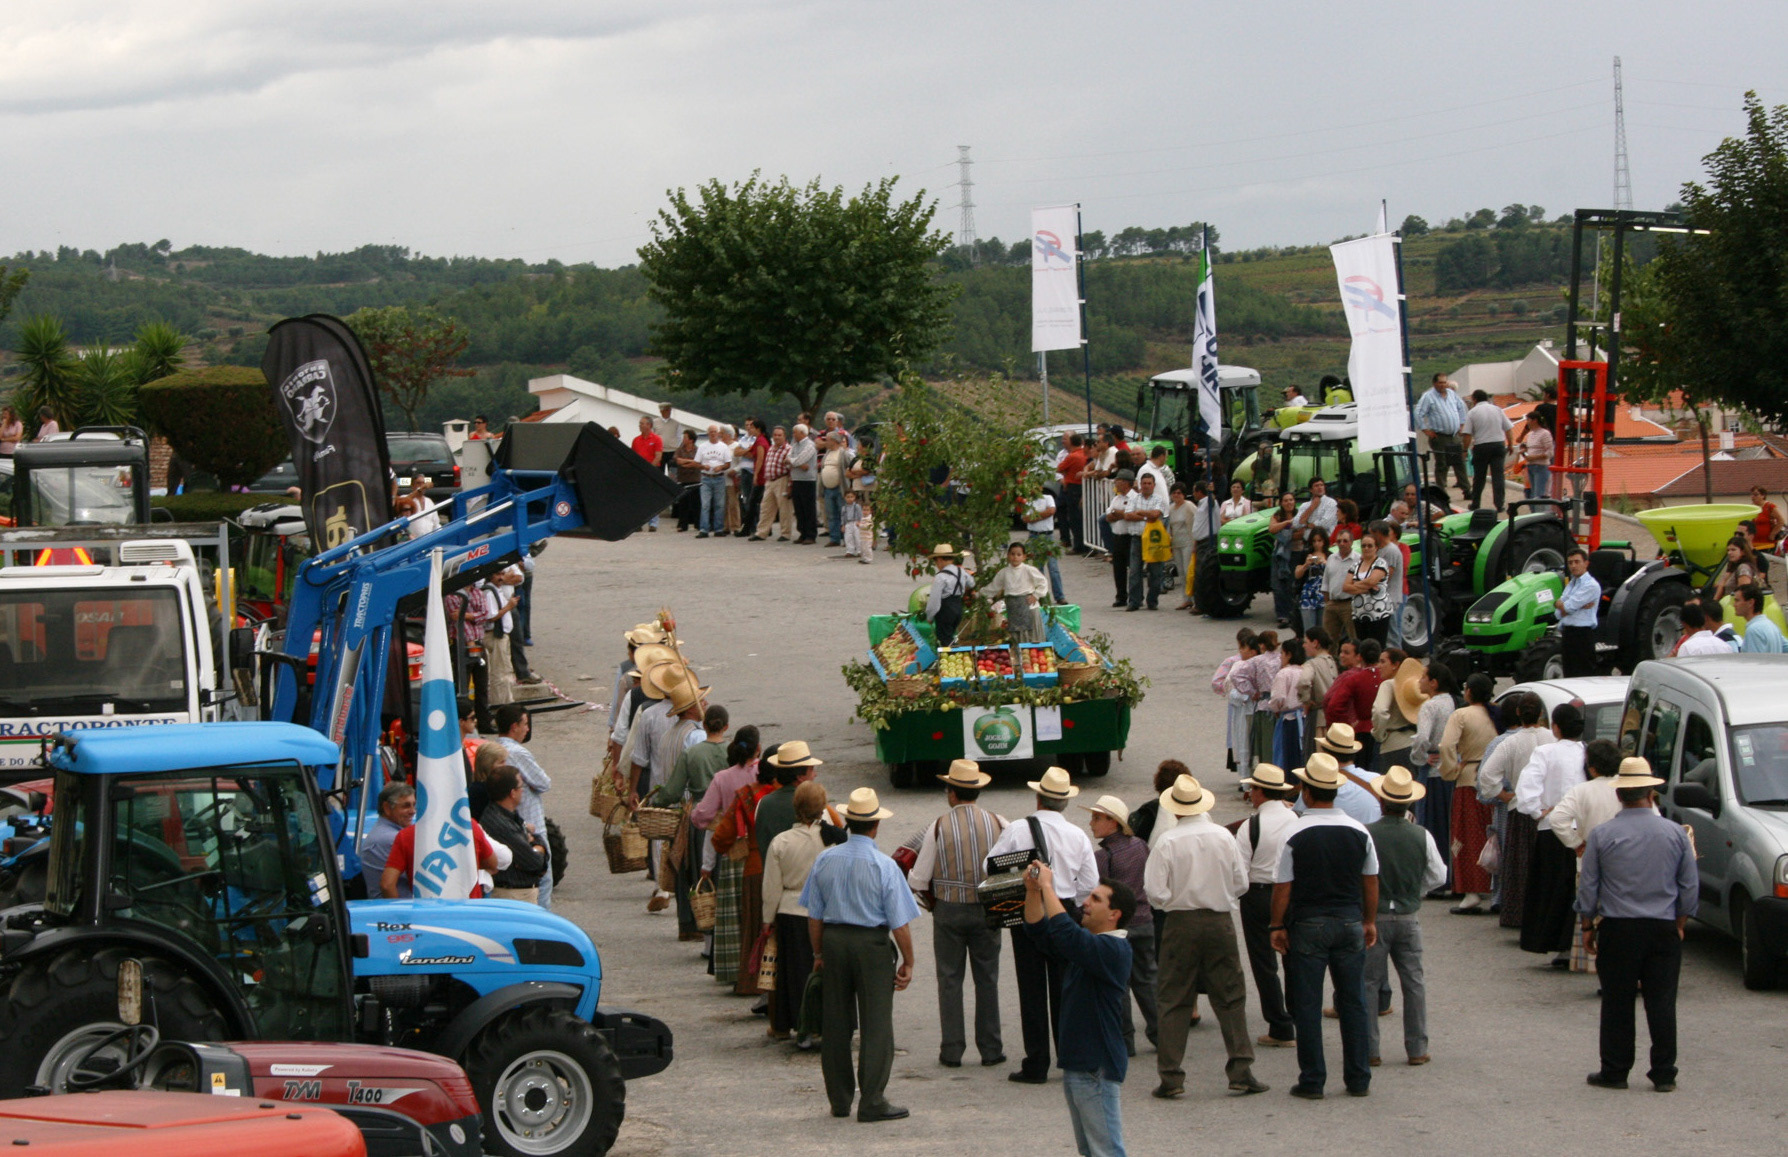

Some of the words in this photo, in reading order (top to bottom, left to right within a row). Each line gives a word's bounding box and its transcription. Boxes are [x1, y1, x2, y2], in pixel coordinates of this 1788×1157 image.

[466, 544, 490, 562] M2
[10, 757, 24, 766] DO
[377, 921, 412, 932] Rex
[400, 952, 475, 965] Landini
[283, 1079, 322, 1100] TYM
[347, 1079, 383, 1104] T400
